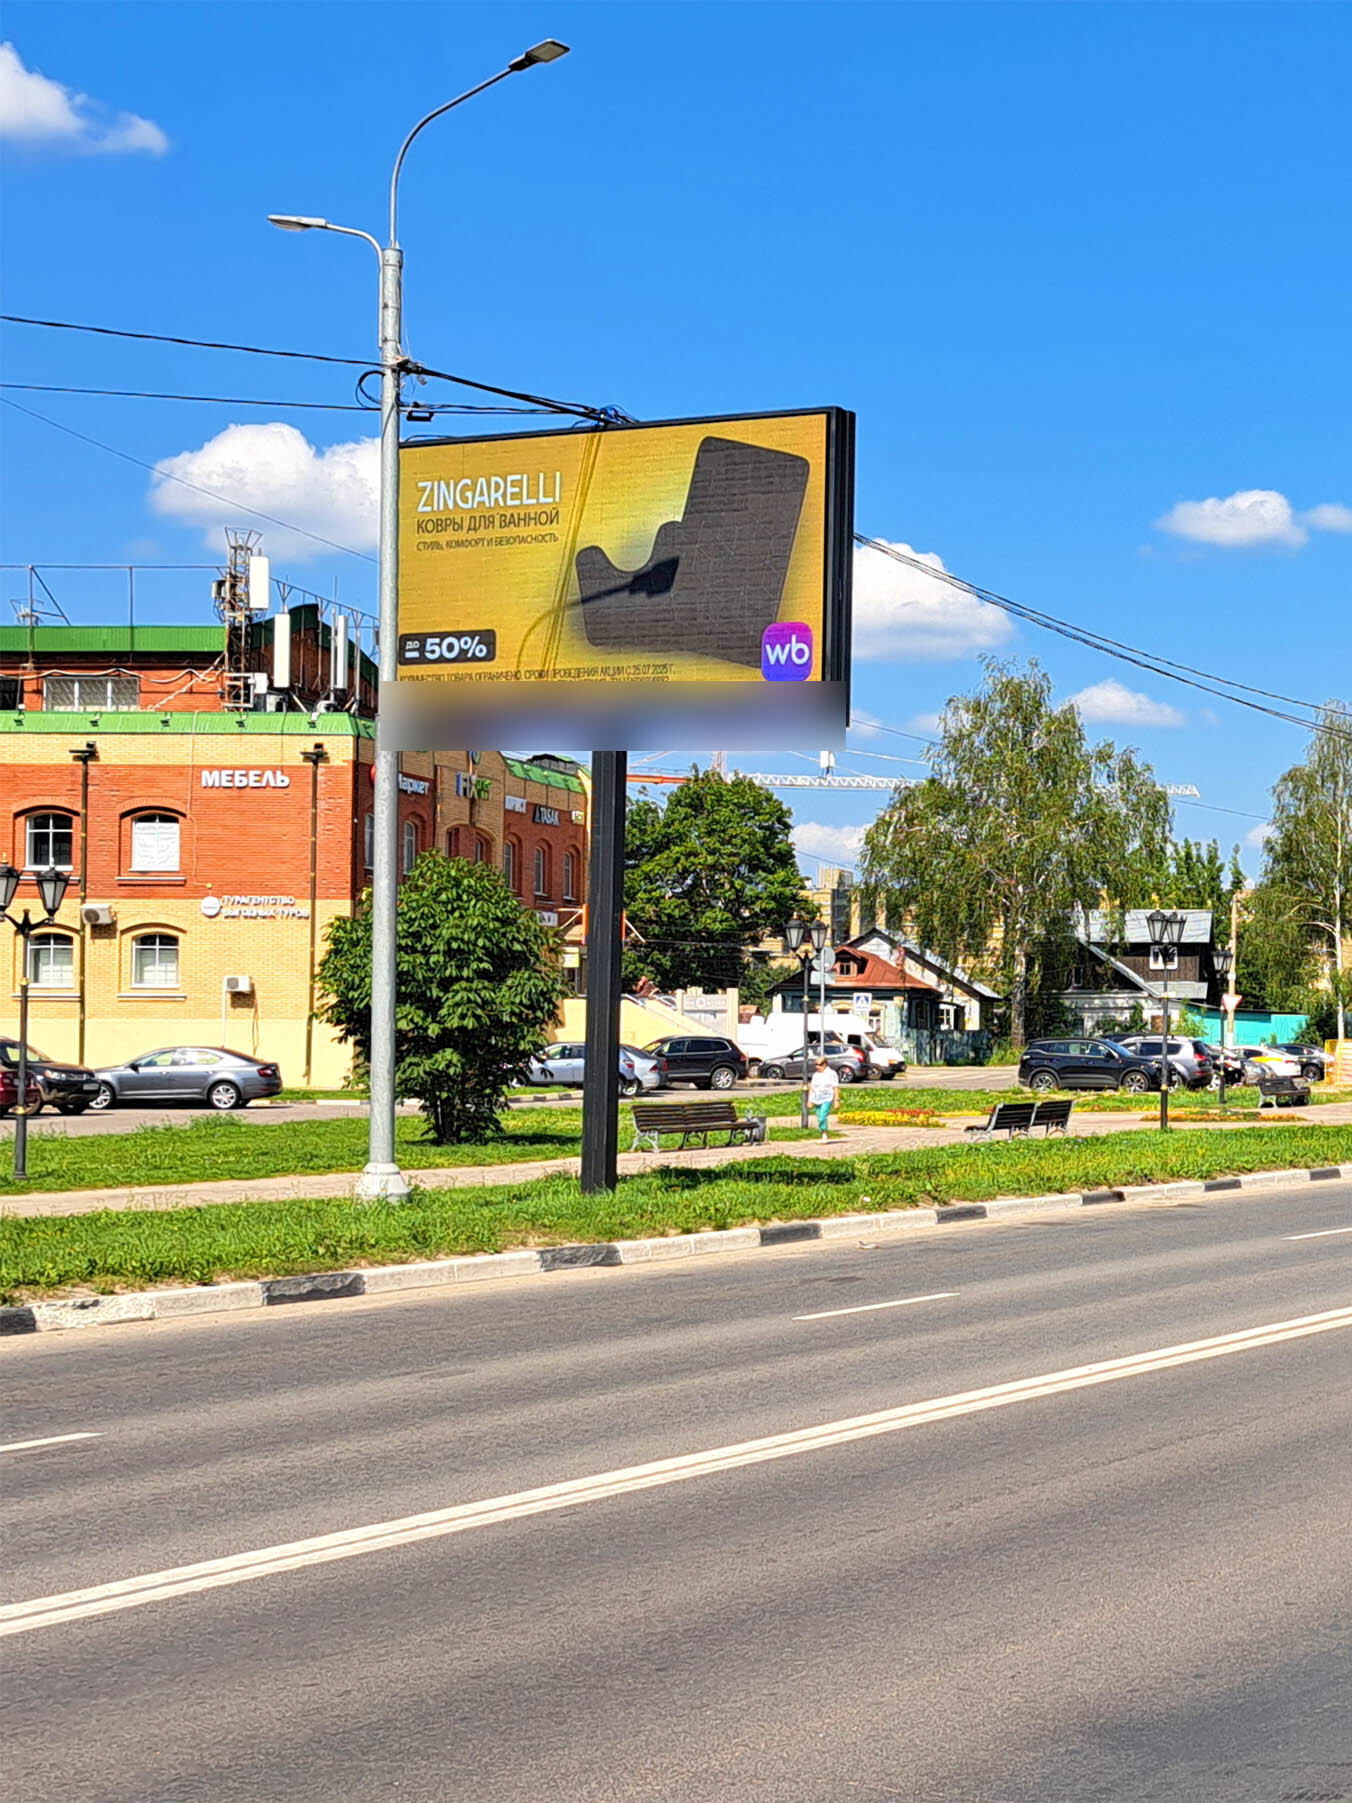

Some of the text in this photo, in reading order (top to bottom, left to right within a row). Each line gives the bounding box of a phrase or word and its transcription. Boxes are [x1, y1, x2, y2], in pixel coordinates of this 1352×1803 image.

[417, 472, 561, 512] ZINGARELLI
[416, 507, 560, 535] КОВРЫ ДЛЯ ВАННОЙ
[446, 537, 486, 549] КОМФОРТ
[494, 532, 559, 547] БЕЗОПАСНОСТЬ
[765, 633, 810, 665] wb
[201, 769, 290, 788] МЕБЕЛЬ
